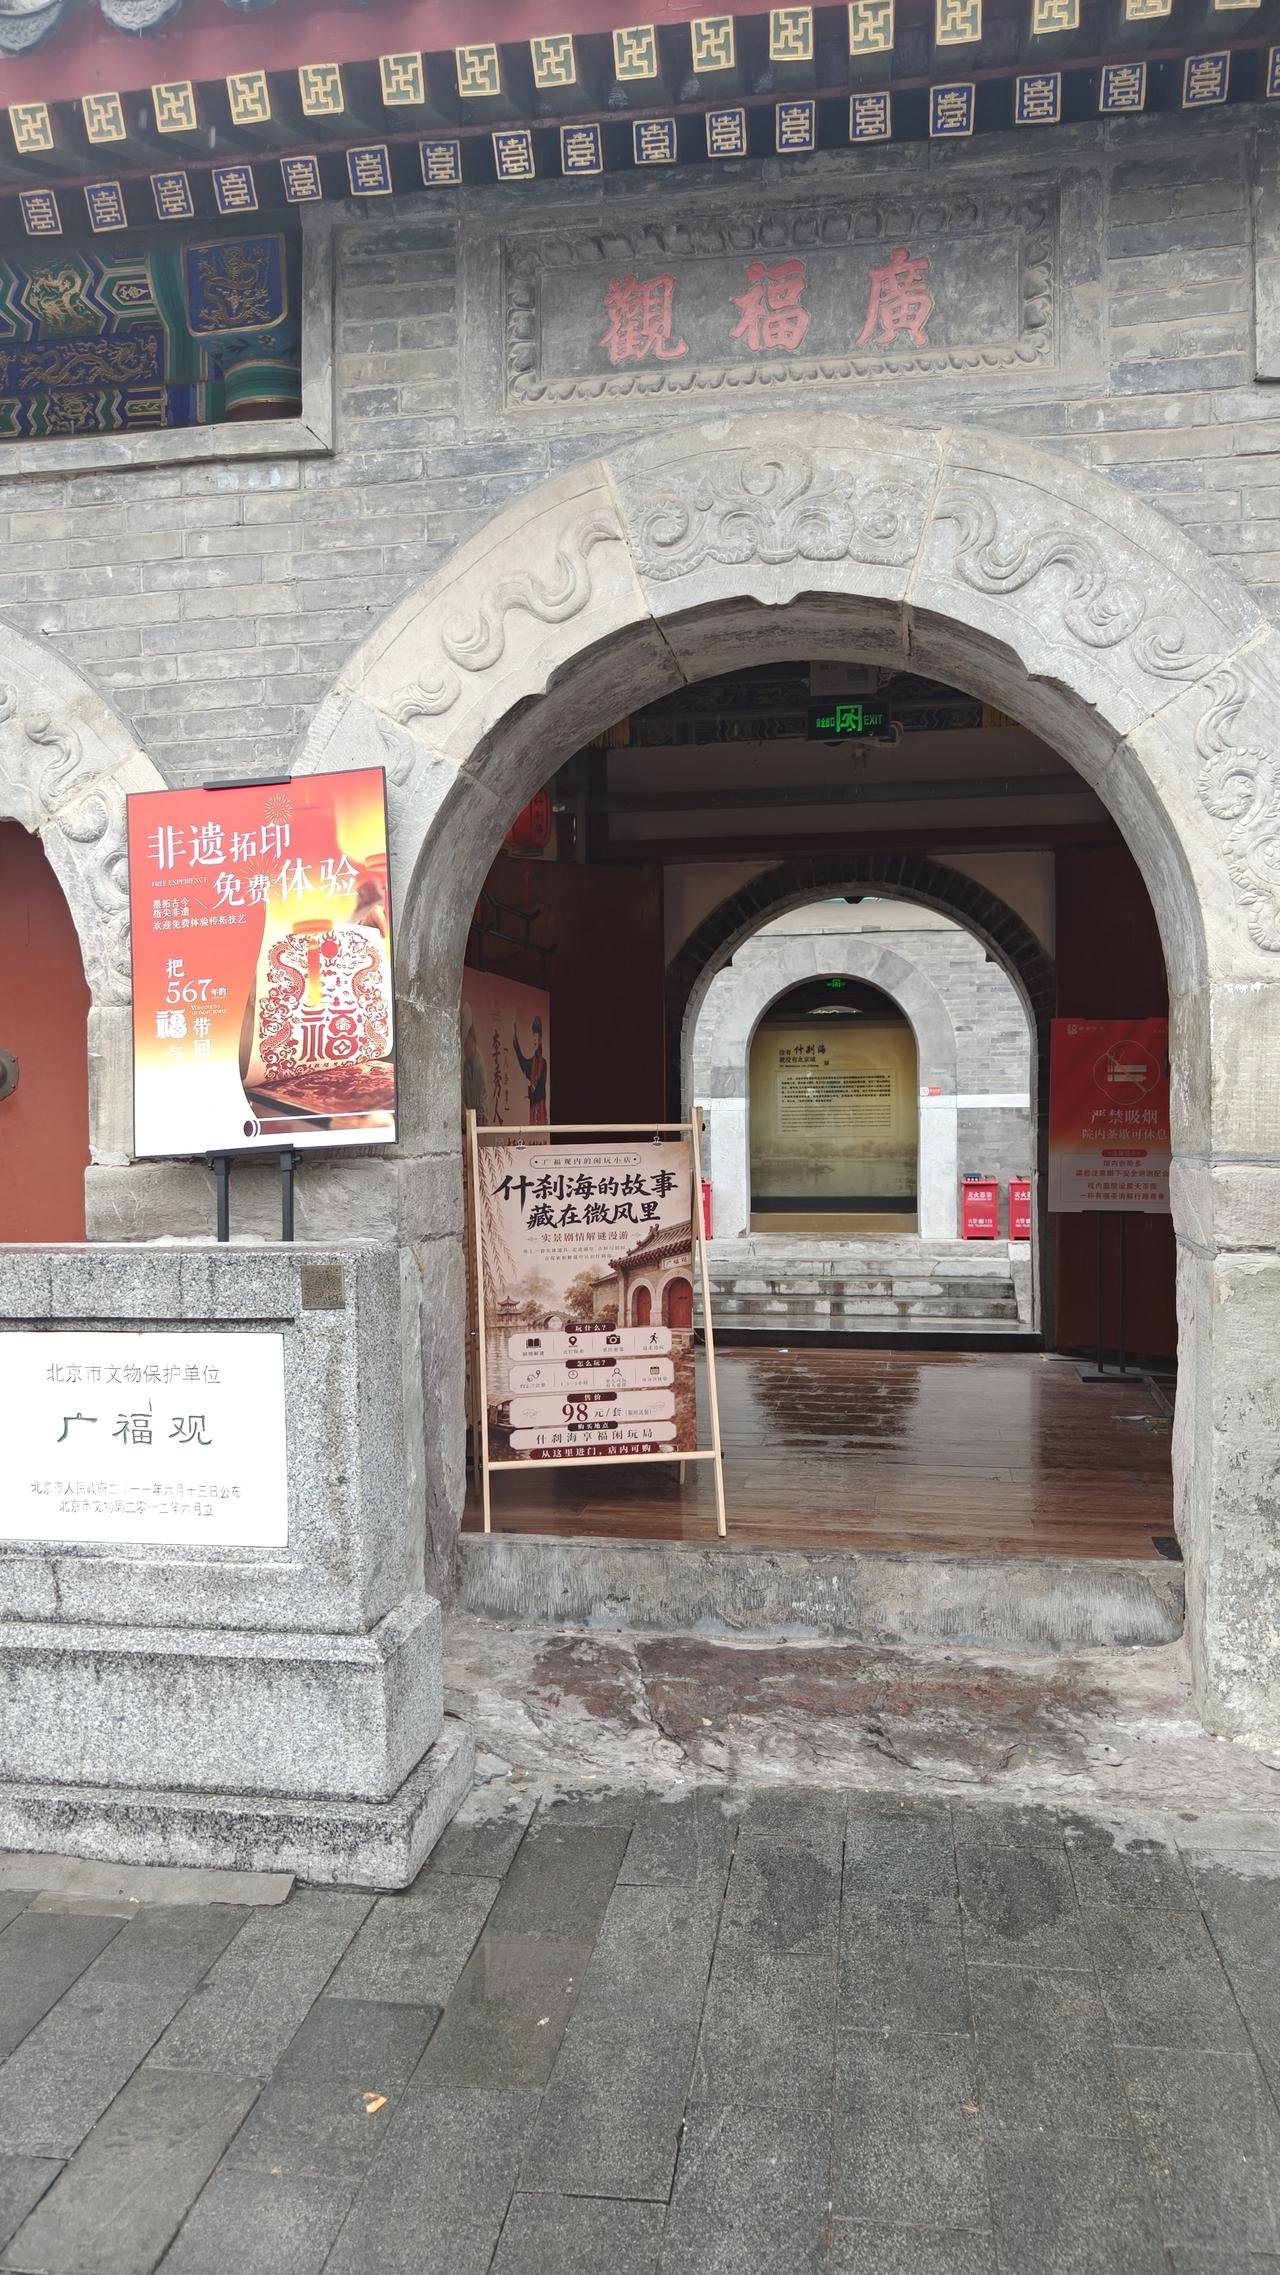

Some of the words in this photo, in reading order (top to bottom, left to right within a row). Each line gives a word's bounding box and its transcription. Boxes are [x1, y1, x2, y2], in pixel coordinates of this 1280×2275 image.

[864, 714, 882, 725] EXIT
[147, 821, 290, 870] 非遗拓印
[212, 853, 360, 910] 免费体验
[166, 958, 185, 978] 把
[1091, 1109, 1158, 1124] 严禁吸烟
[492, 1169, 679, 1213] 什刹海的故事
[525, 1199, 661, 1231] 藏在微风里
[541, 1230, 630, 1243] 实景剧情解谜漫游
[46, 1363, 221, 1383] 北京市文物保护单位
[562, 1403, 588, 1423] 98
[57, 1412, 212, 1445] 广福观
[536, 1429, 653, 1445] 什刹海享福闲玩局
